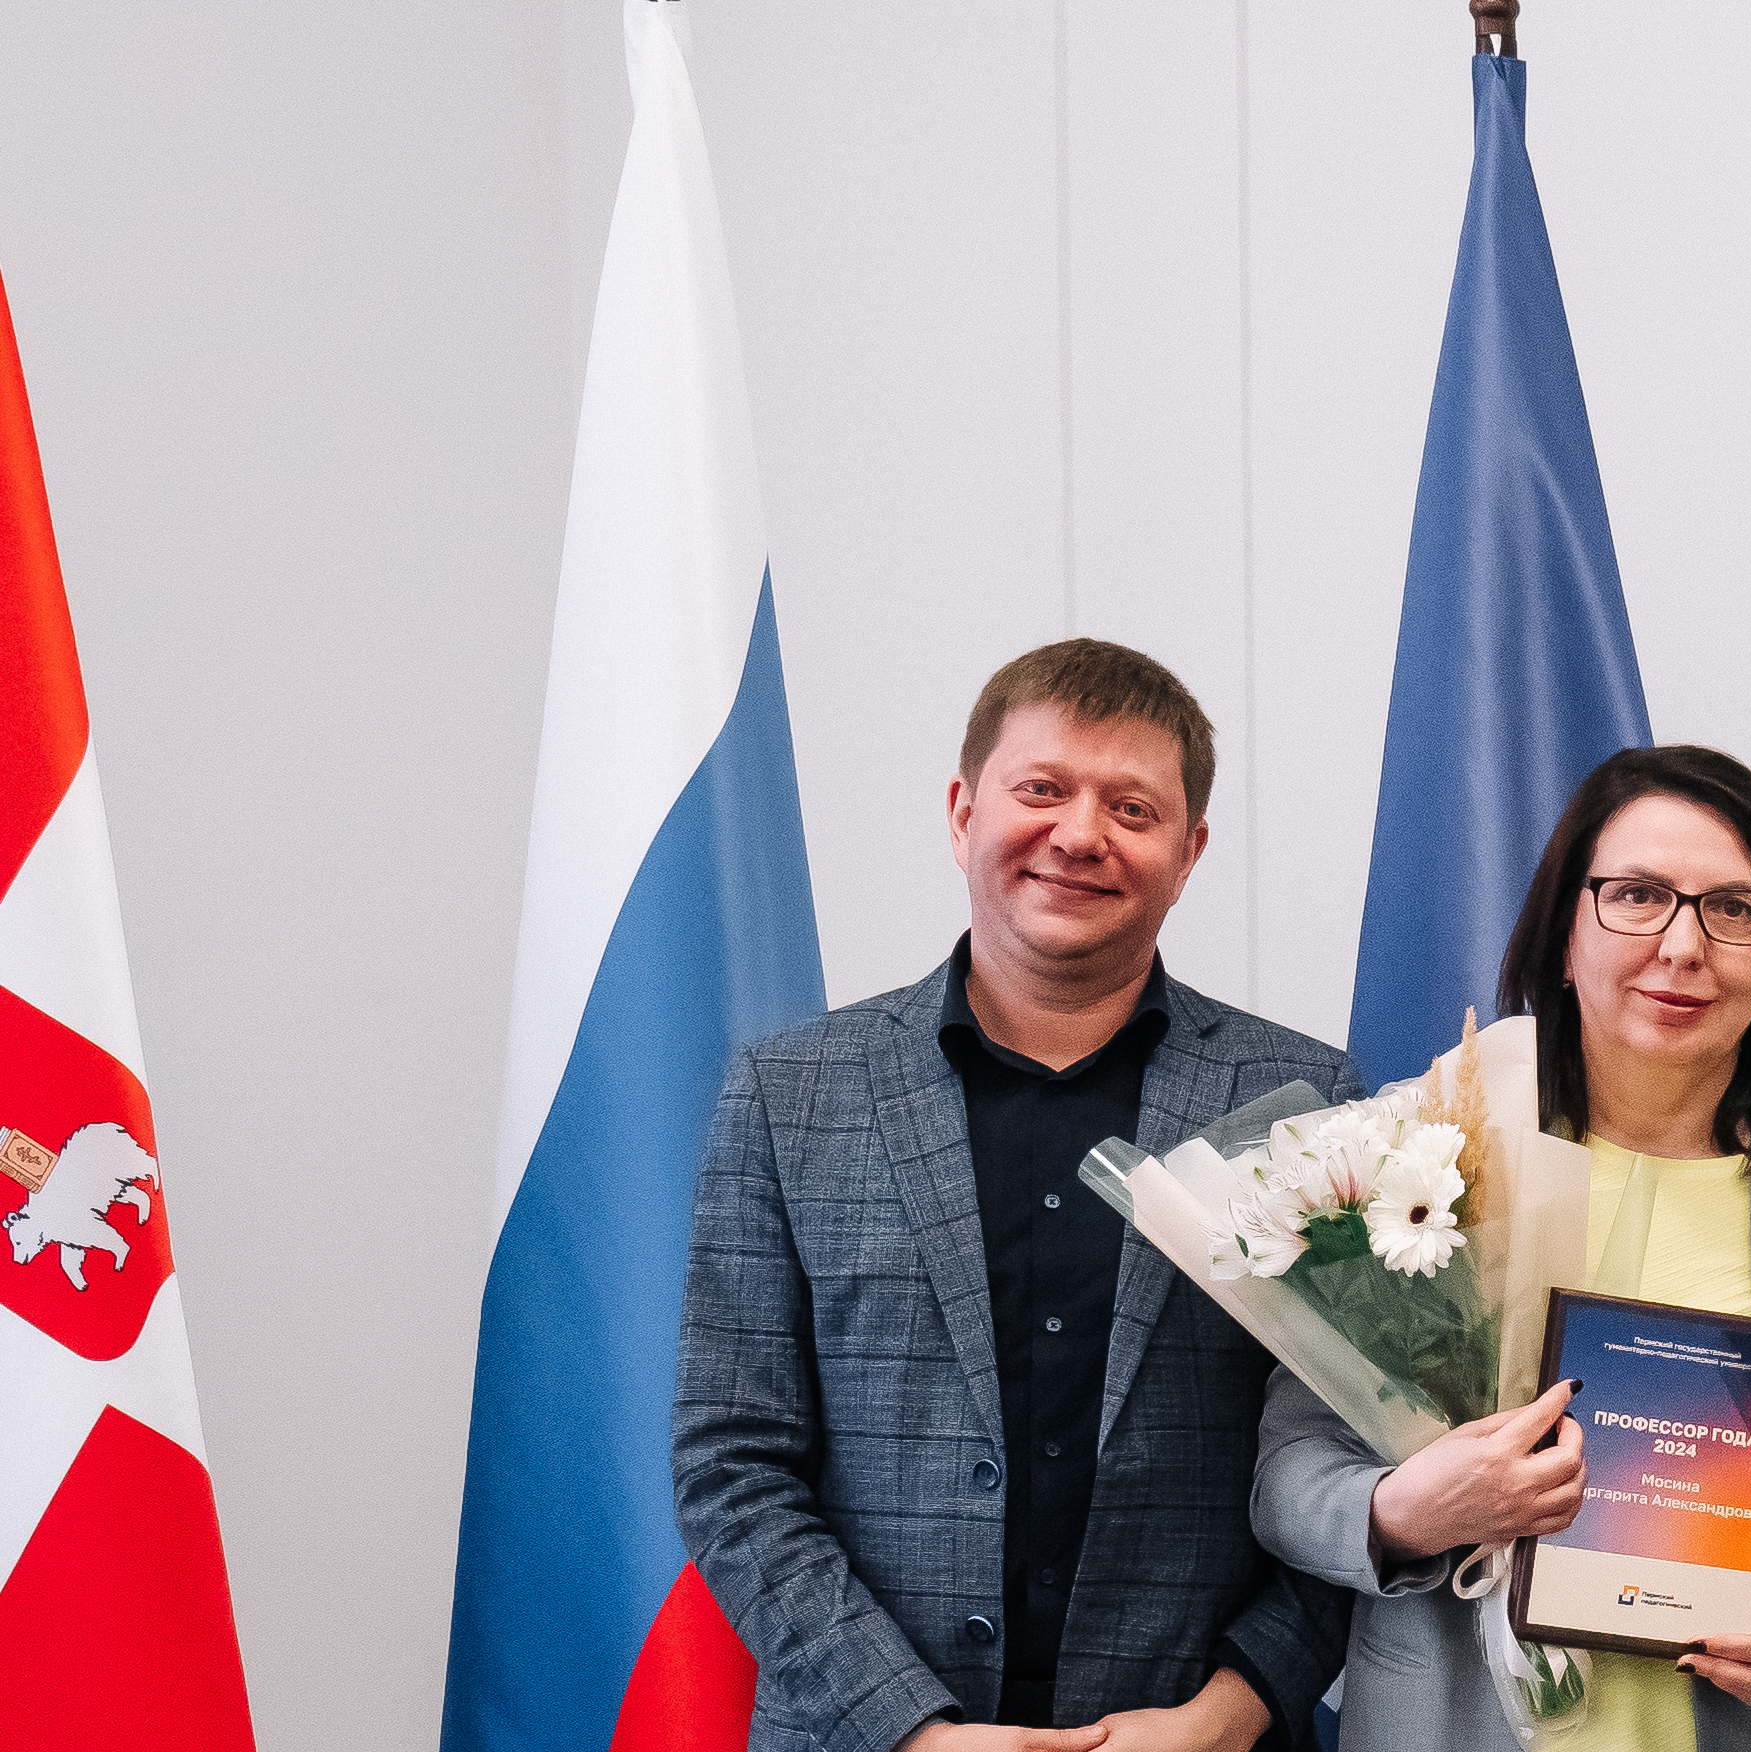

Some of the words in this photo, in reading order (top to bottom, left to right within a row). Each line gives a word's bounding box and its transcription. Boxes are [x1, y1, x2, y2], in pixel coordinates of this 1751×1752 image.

[1593, 1410, 1709, 1441] ПРОФЕССОР
[1652, 1439, 1698, 1459] 2024
[1640, 1473, 1701, 1493] Мосина
[1583, 1486, 1648, 1505] ргарита
